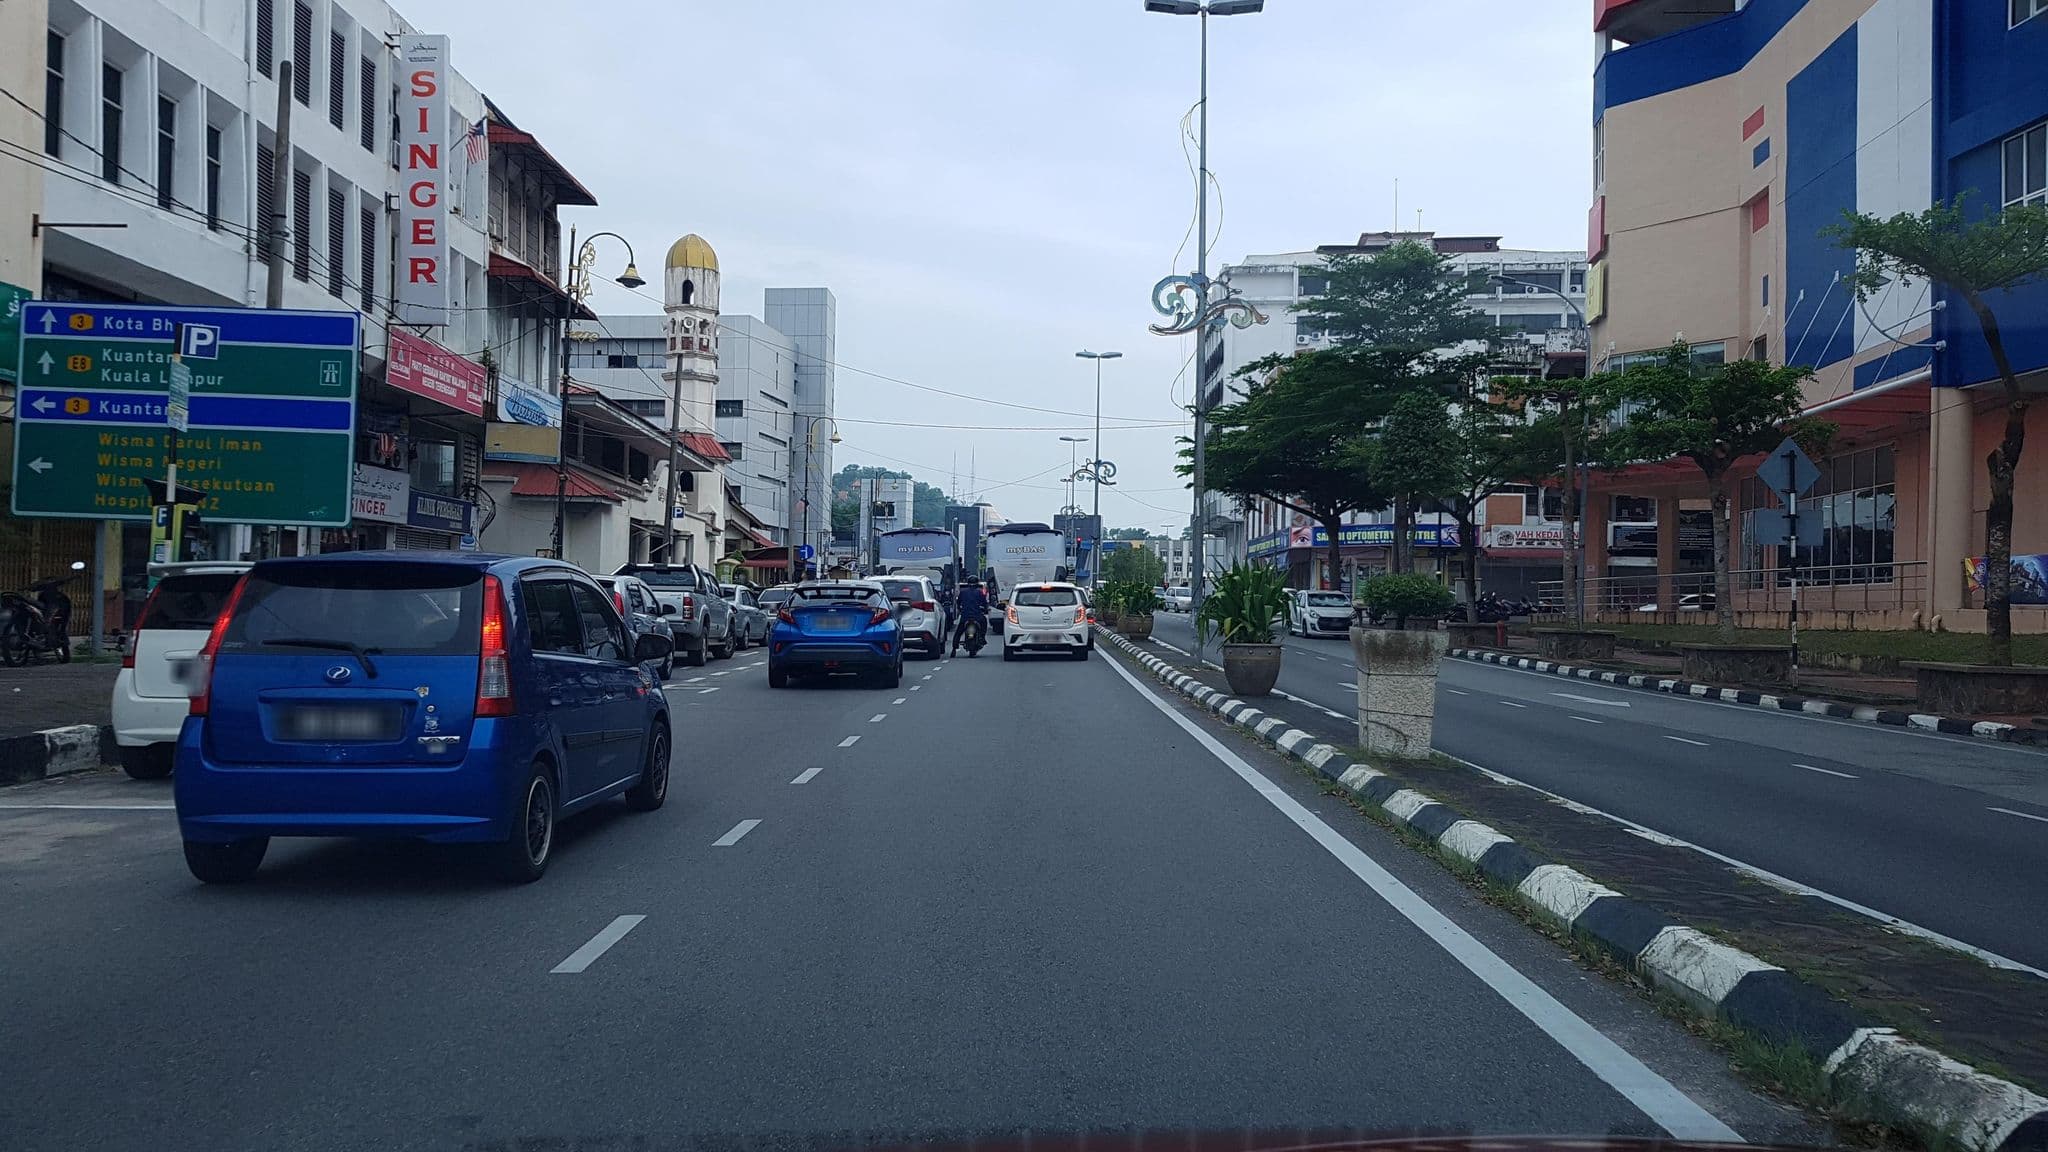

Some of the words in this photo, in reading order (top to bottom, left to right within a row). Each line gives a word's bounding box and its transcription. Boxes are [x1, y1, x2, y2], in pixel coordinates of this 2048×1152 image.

[408, 71, 438, 283] SINGER
[76, 315, 84, 328] 3
[104, 316, 144, 331] Kota
[189, 327, 214, 354] P
[73, 356, 86, 370] E8
[101, 368, 151, 383] Kuala
[73, 399, 80, 411] 3
[98, 432, 155, 448] Wisma
[220, 436, 262, 451] Iman
[97, 452, 153, 468] Wisma
[96, 472, 143, 488] Wism
[353, 497, 386, 516] INGER
[674, 507, 683, 517] P
